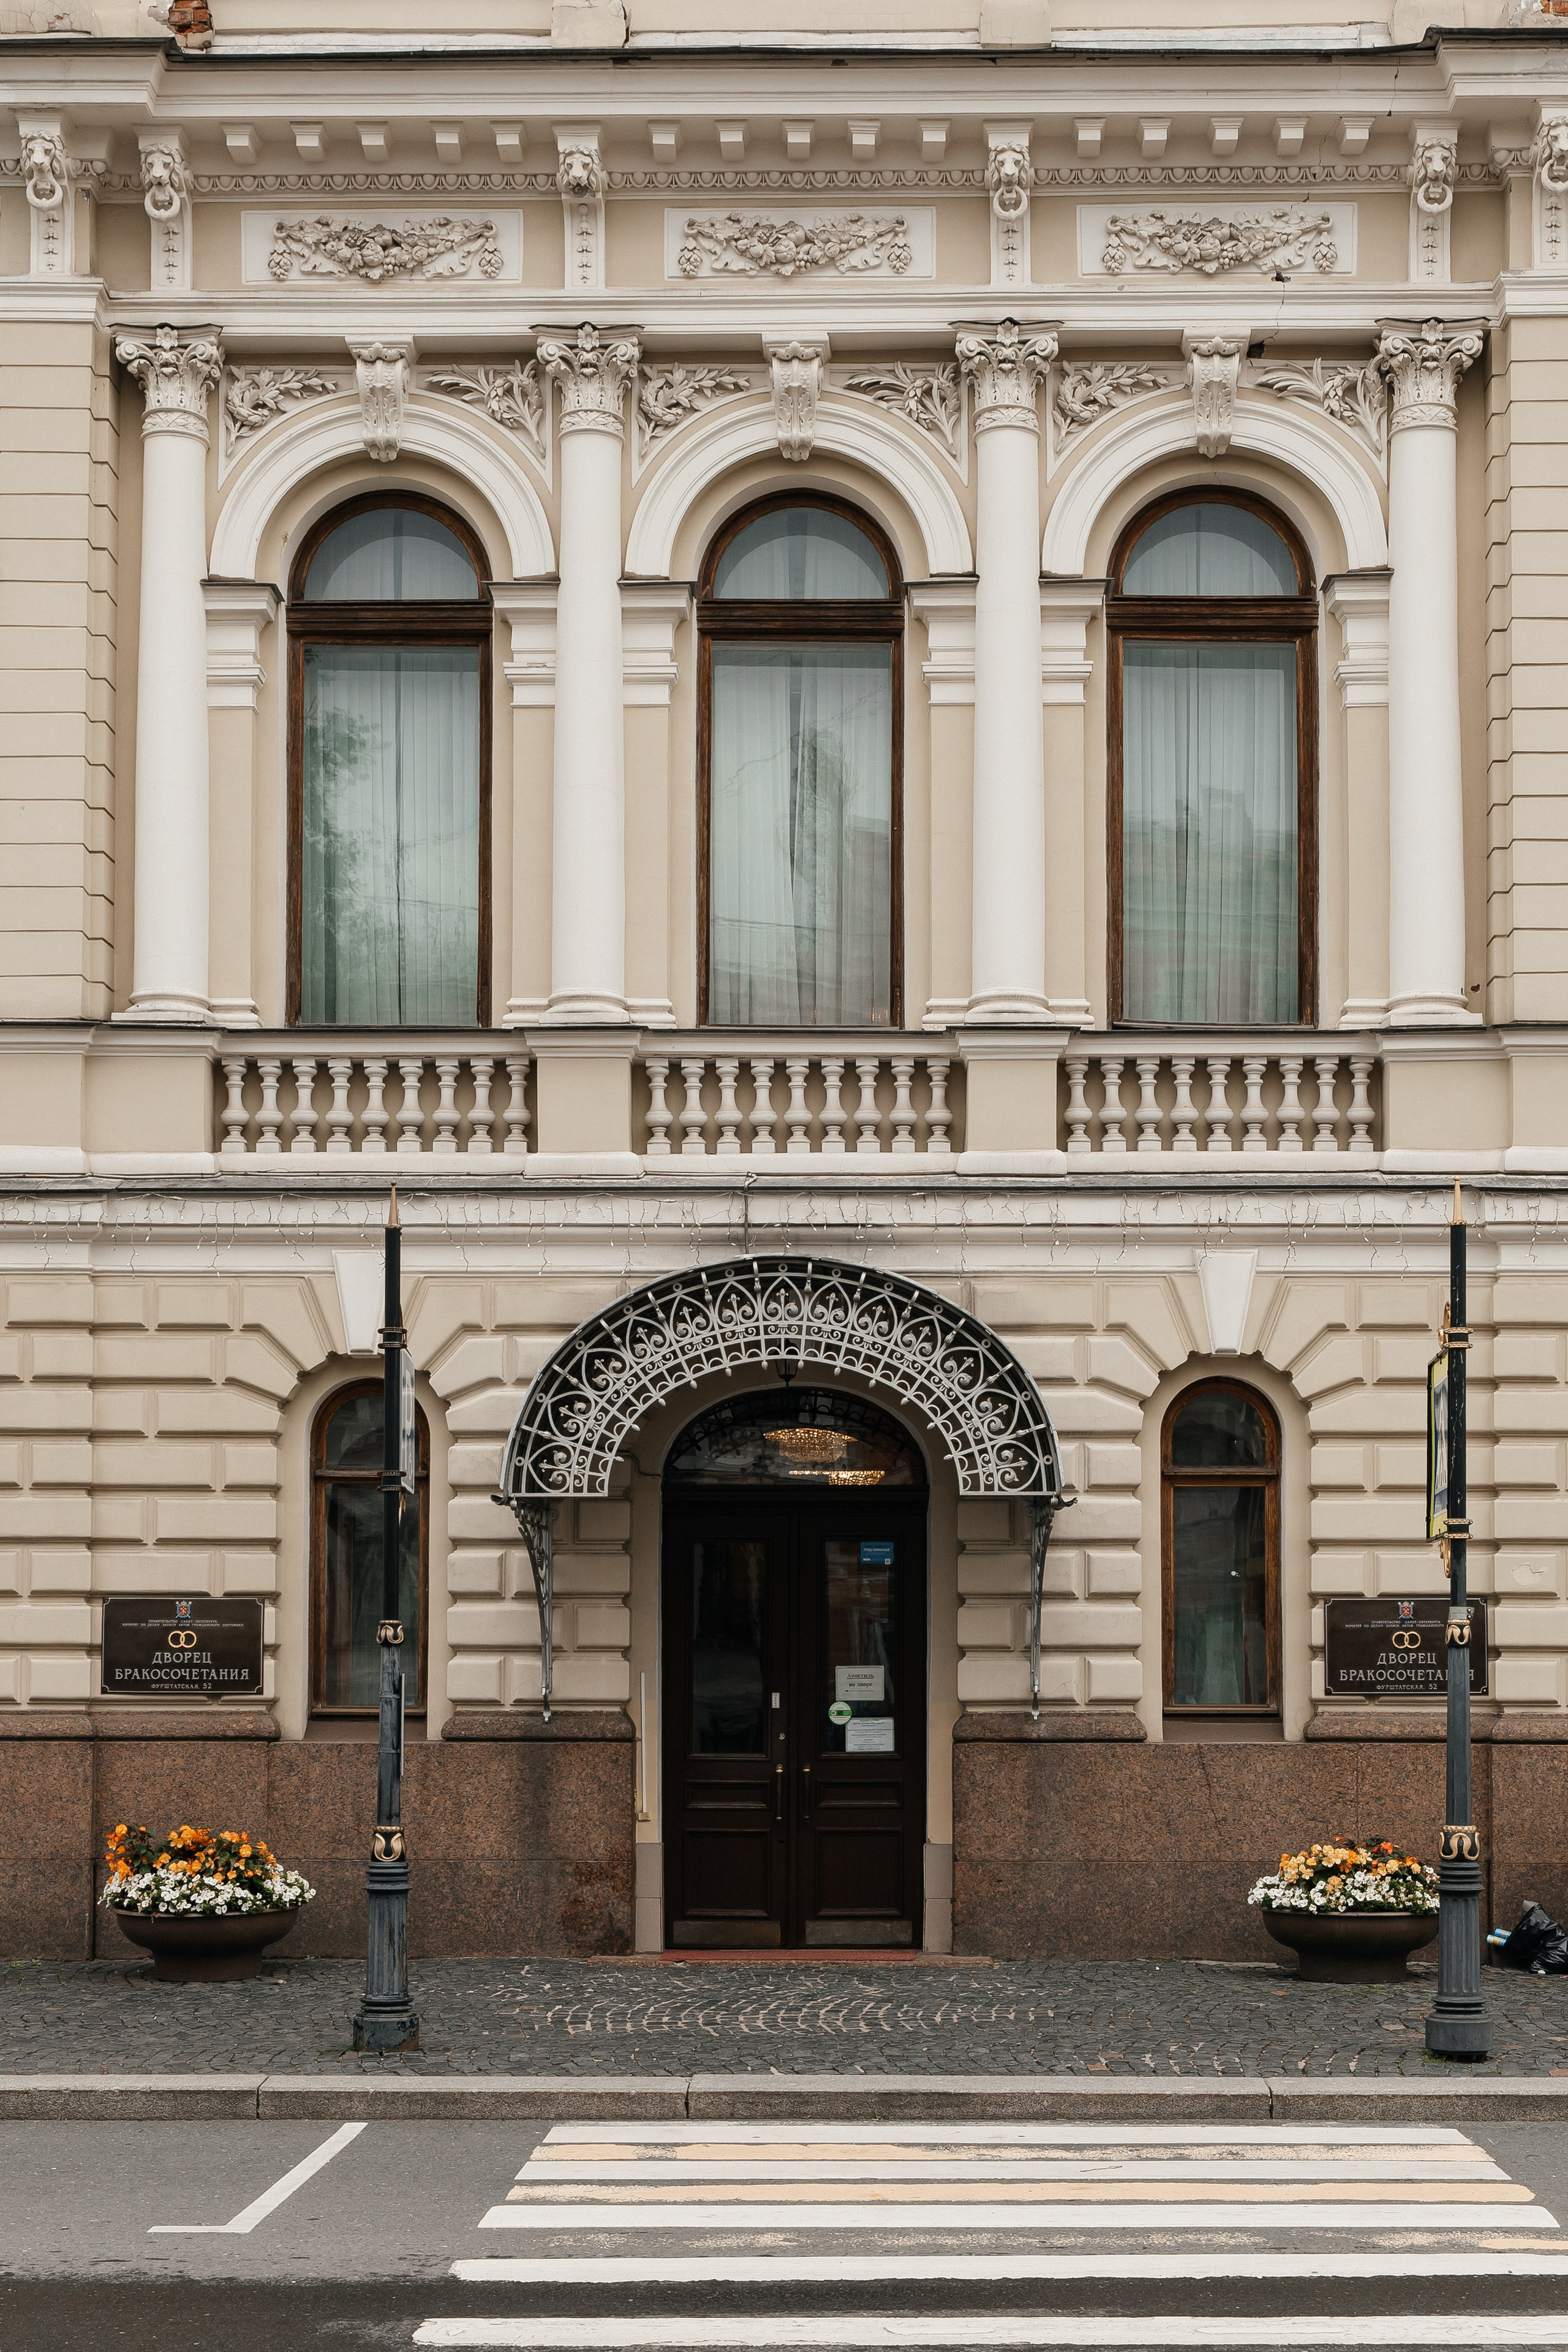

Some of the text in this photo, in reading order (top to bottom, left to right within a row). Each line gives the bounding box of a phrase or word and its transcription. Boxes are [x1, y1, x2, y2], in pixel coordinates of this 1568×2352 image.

[152, 1652, 212, 1665] ДВОРЕЦ
[1376, 1653, 1437, 1665] ДВОРЕЦ
[115, 1668, 249, 1680] БРАКОСОЧЕТАНИЯ
[1340, 1670, 1474, 1681] БРАКОСОЧЕТАЯ
